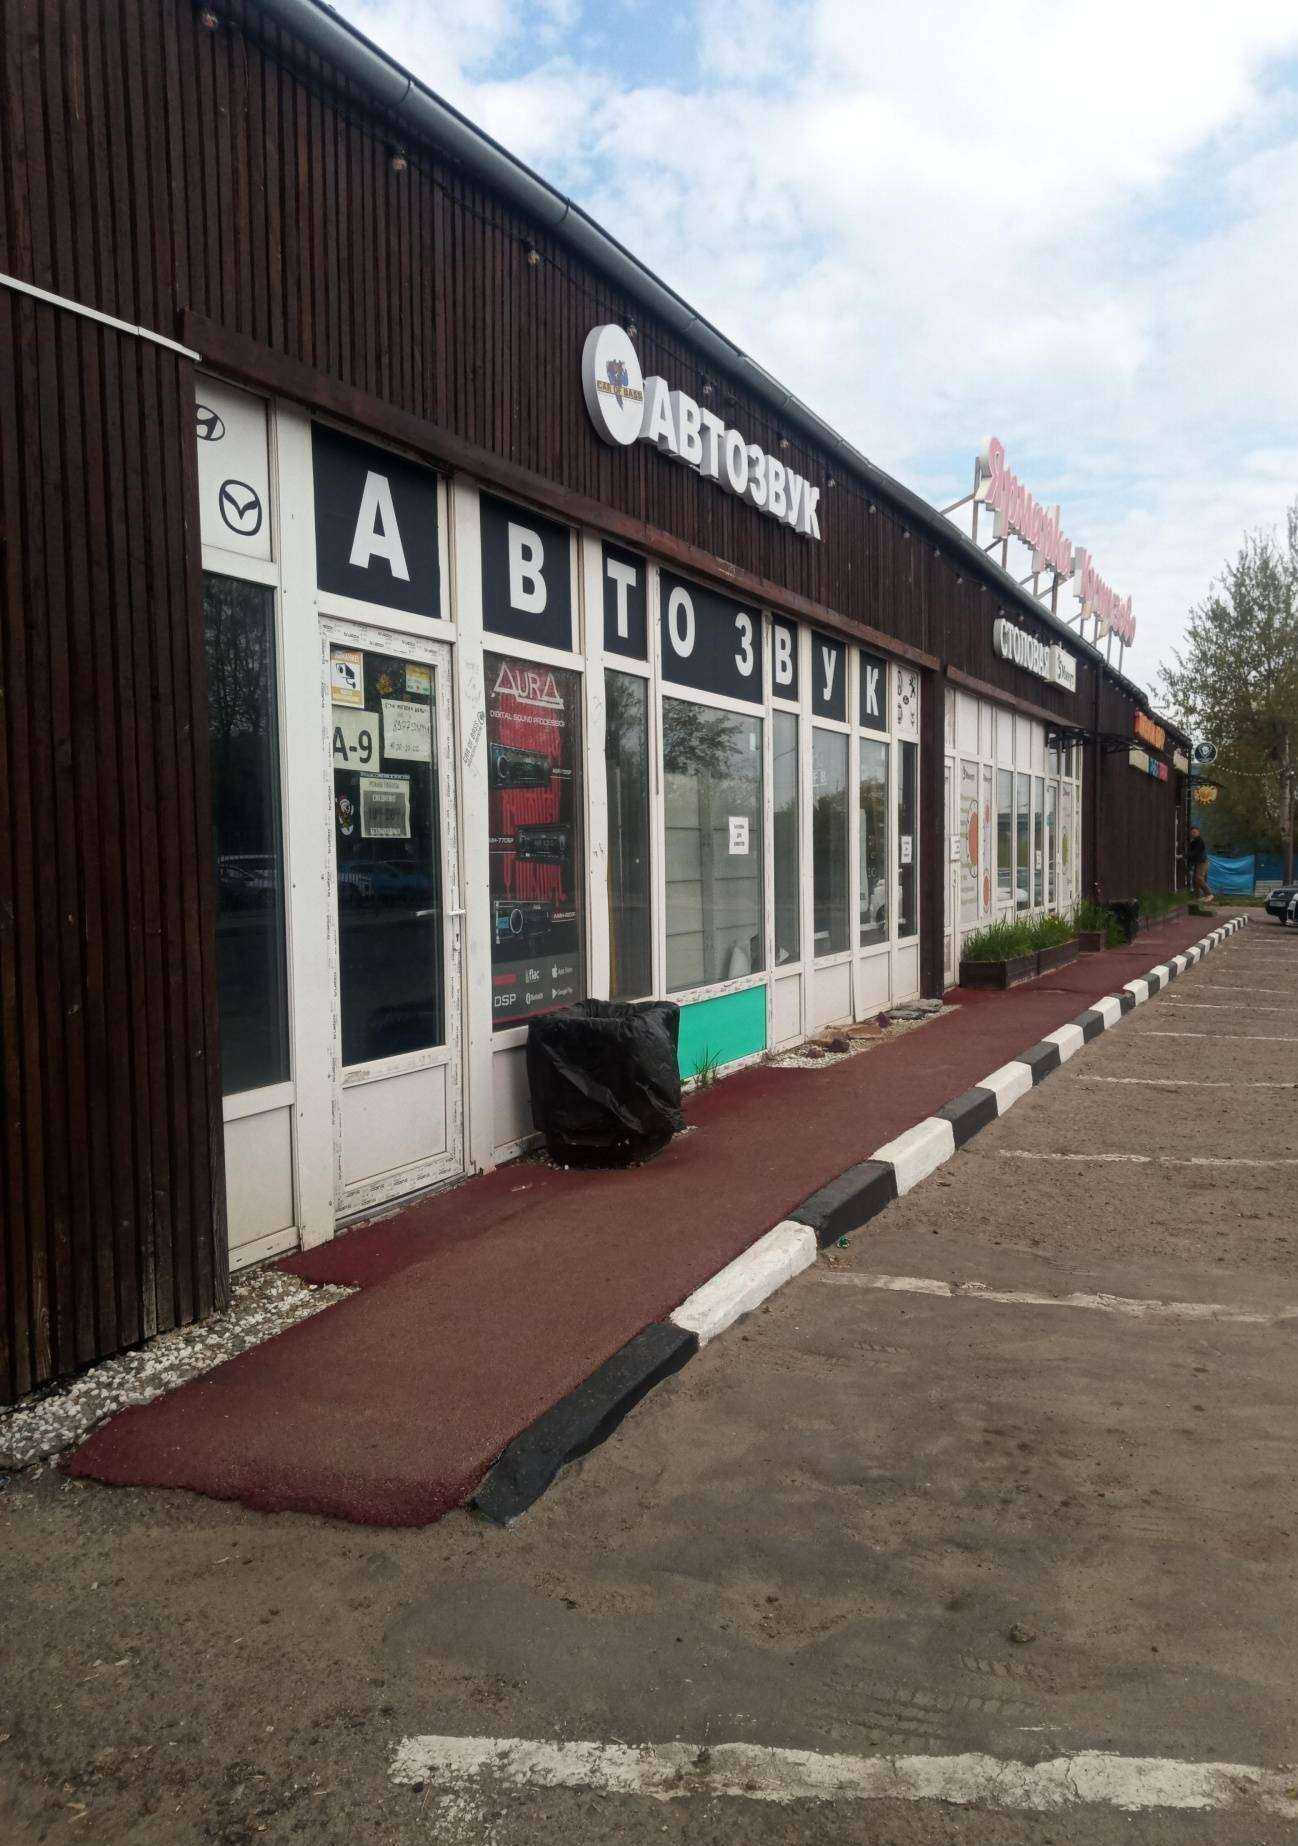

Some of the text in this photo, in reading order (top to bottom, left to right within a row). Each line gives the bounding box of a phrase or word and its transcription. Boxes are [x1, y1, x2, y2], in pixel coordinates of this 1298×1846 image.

[641, 376, 821, 540] АВТОЗВУК
[994, 618, 1050, 681] СТОЛОВАЯ
[490, 661, 564, 709] AURA
[513, 713, 533, 723] SOUND
[494, 993, 517, 1007] DSP
